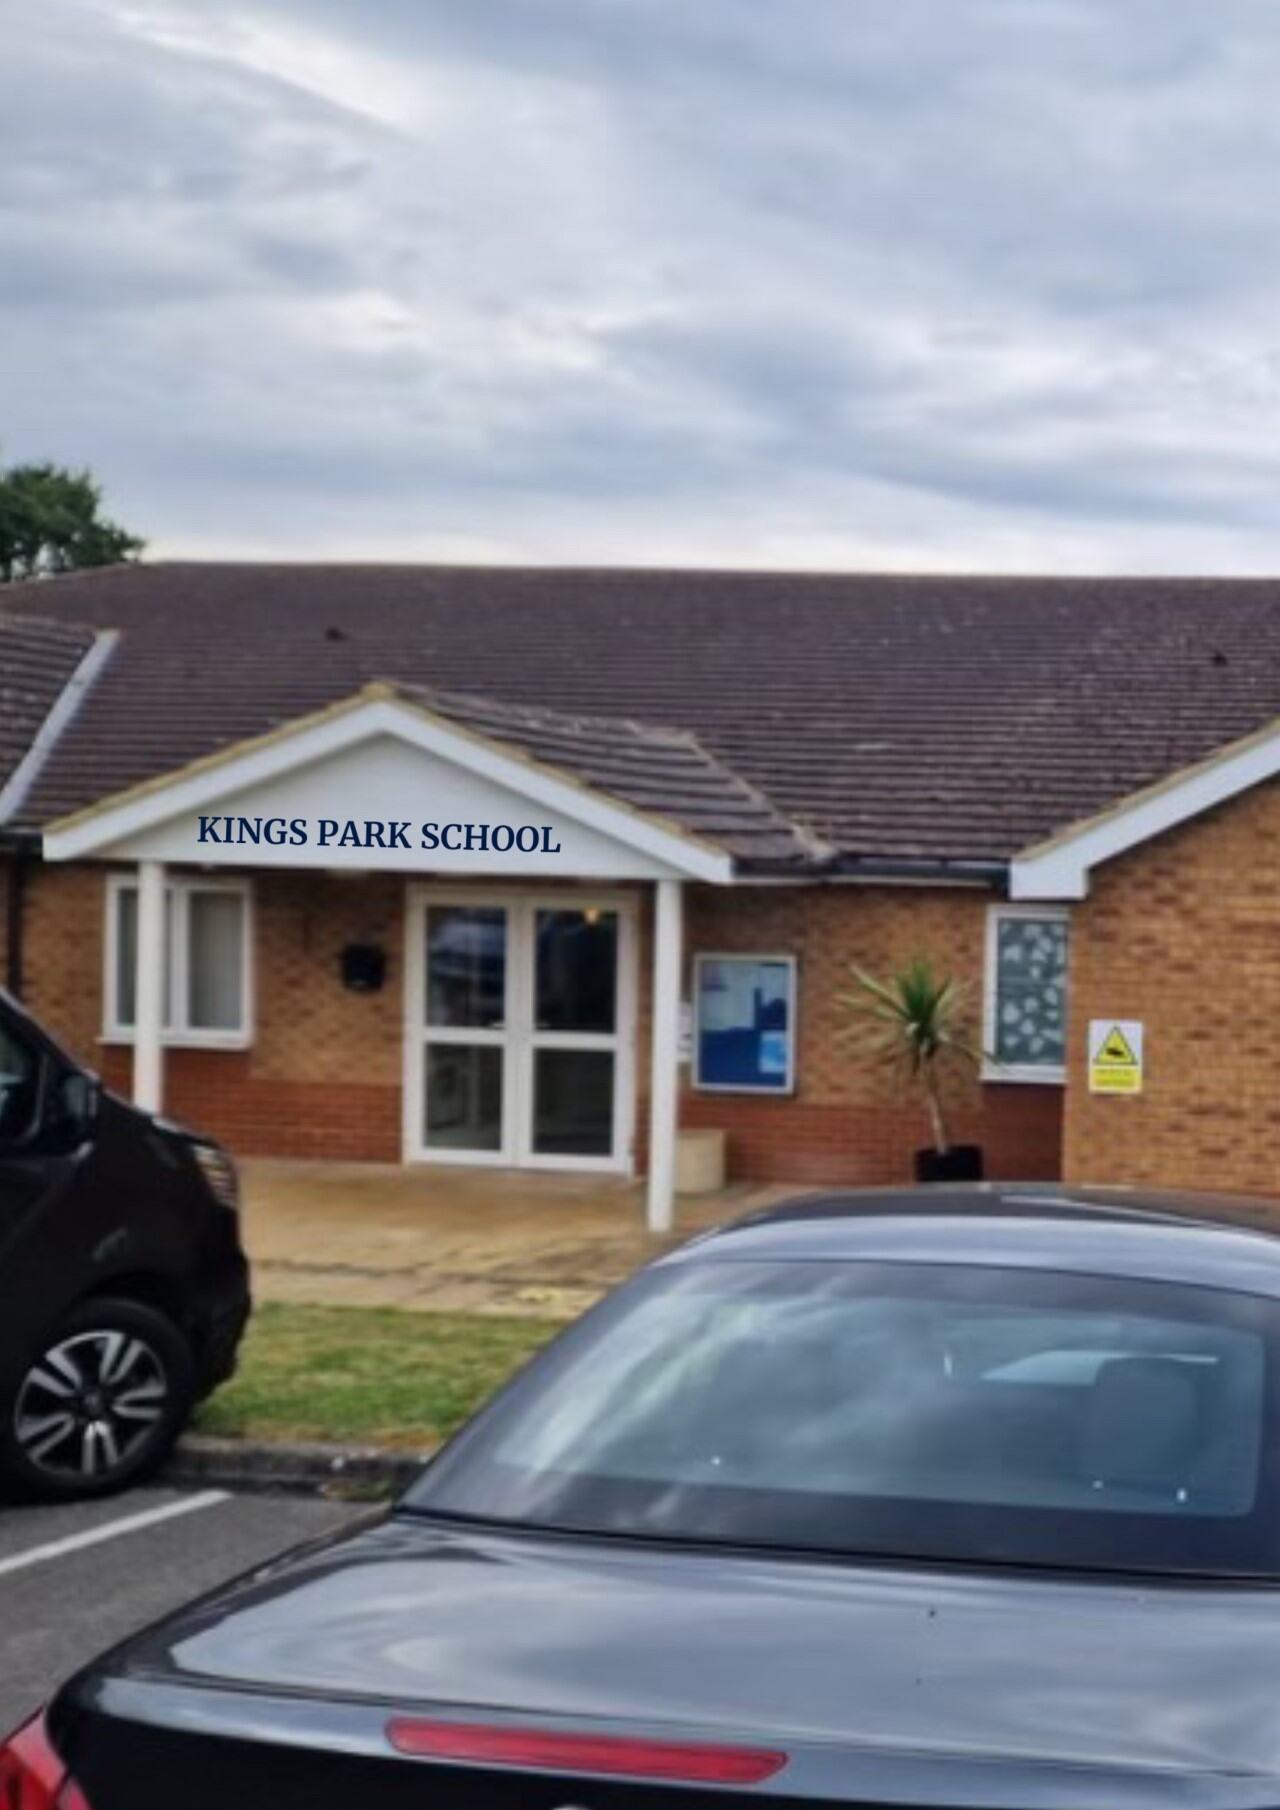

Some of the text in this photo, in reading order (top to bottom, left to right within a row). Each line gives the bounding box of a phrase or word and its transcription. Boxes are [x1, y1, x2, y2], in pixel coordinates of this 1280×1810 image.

[197, 816, 561, 853] KINGS PARK SCHOOL
